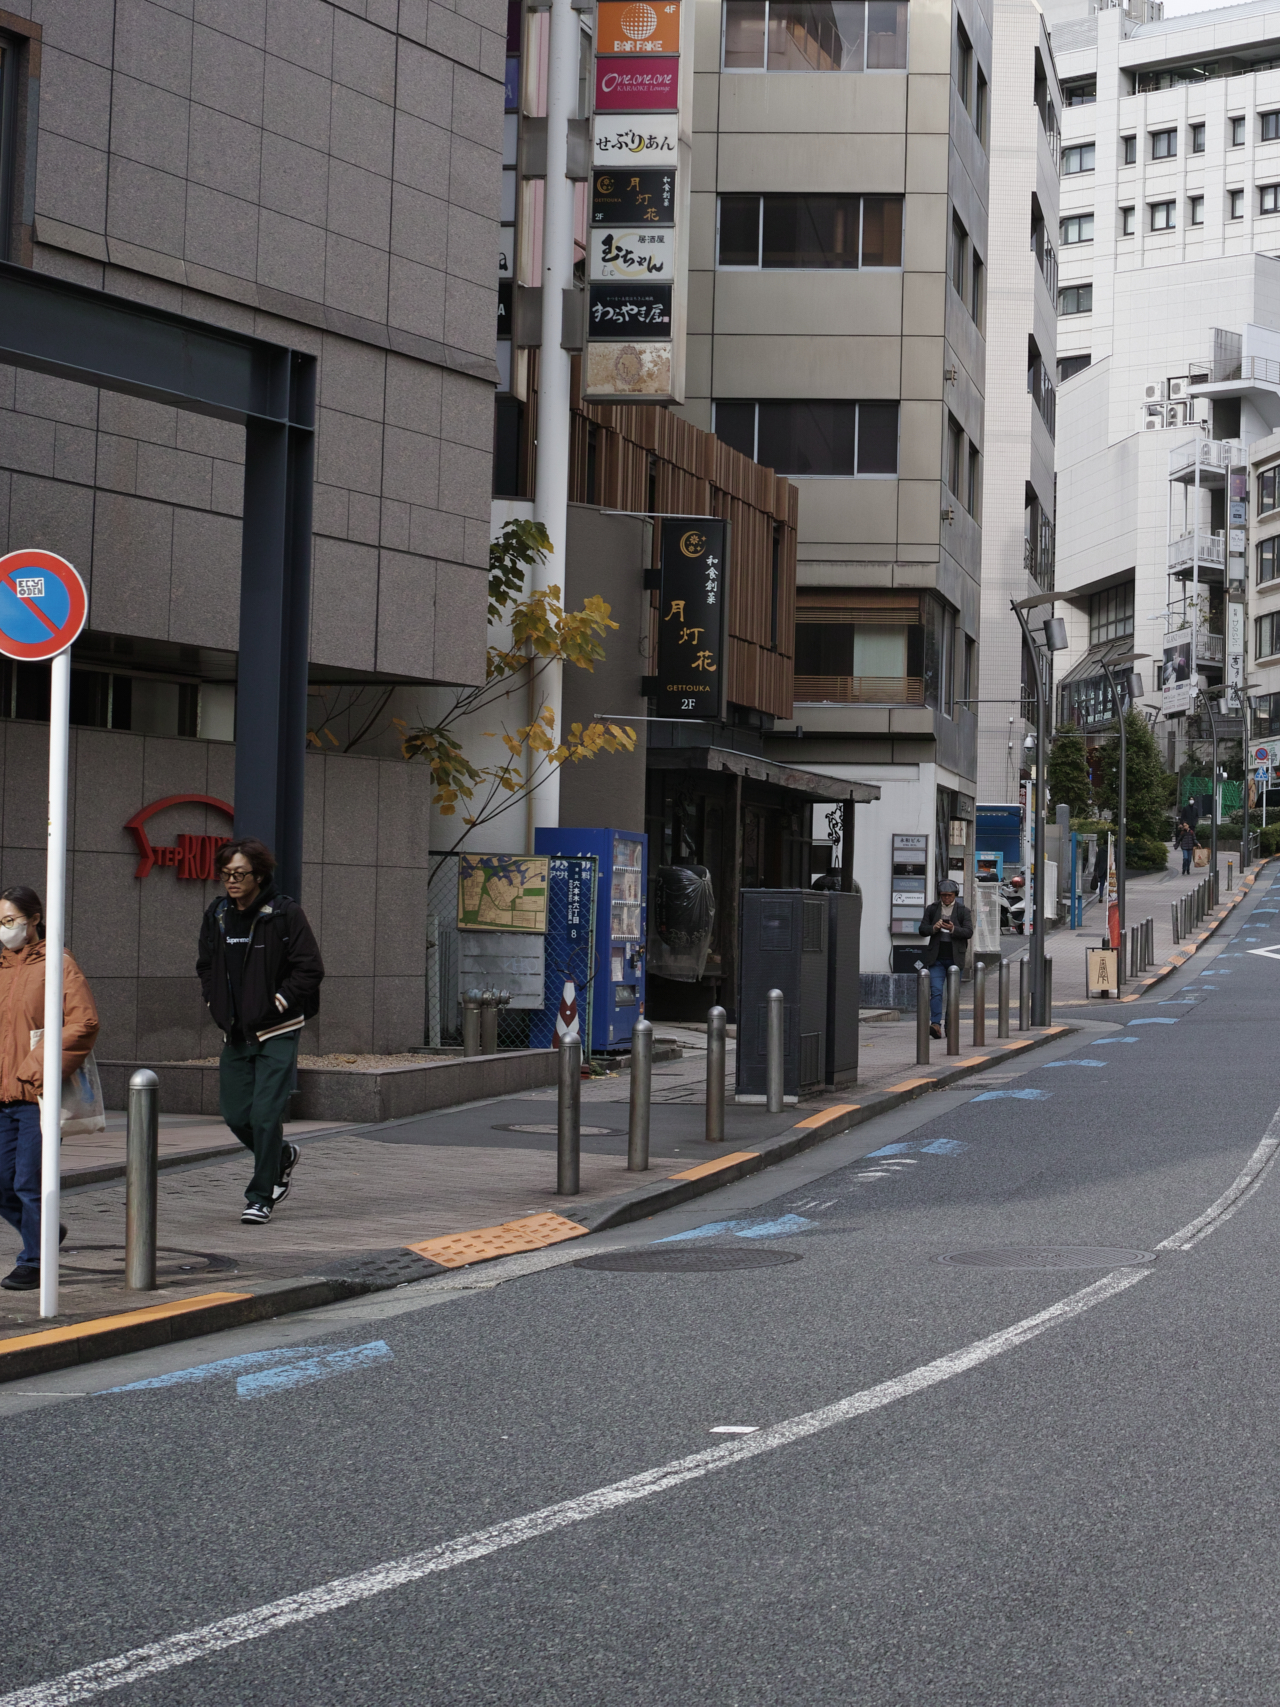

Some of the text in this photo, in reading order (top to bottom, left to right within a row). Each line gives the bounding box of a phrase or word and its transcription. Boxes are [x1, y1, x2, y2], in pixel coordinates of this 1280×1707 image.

[664, 5, 677, 13] 4F
[614, 41, 662, 51] BAR FAKE
[650, 85, 670, 93] Lounge
[596, 129, 675, 153] せぶりあん
[638, 235, 665, 244] 居酒屋
[705, 555, 719, 604] 和食創菜
[664, 600, 717, 671] 月灯花
[667, 684, 711, 692] GETTOUKA
[681, 699, 695, 709] 2F
[571, 929, 577, 938] 8
